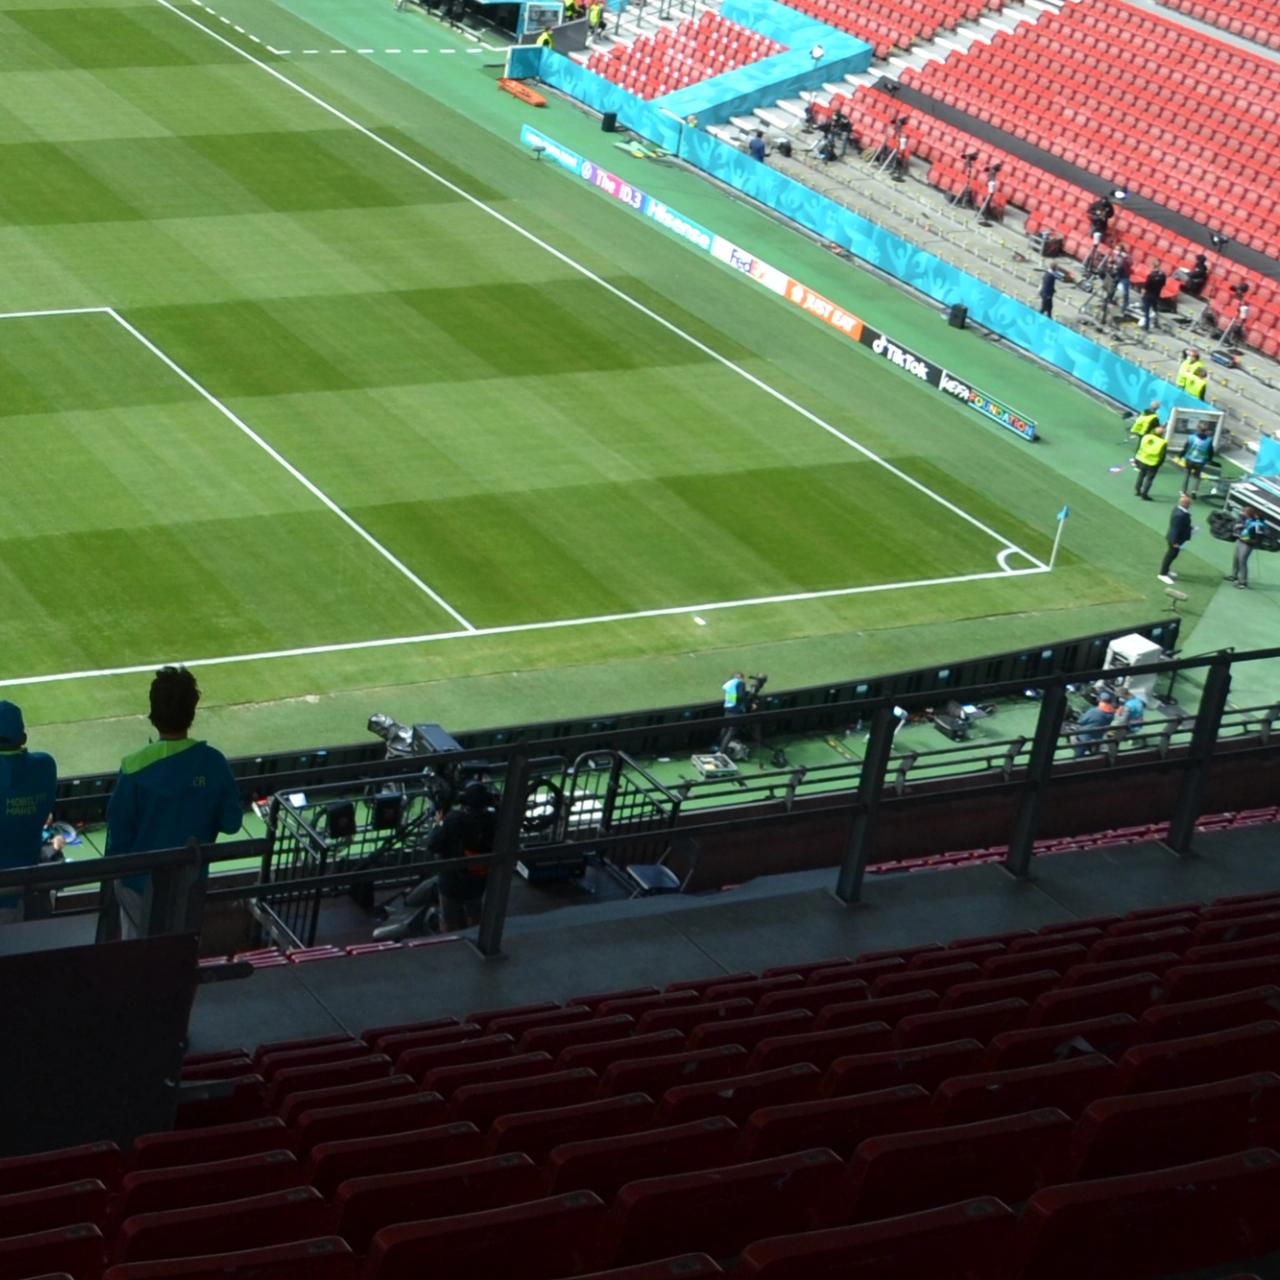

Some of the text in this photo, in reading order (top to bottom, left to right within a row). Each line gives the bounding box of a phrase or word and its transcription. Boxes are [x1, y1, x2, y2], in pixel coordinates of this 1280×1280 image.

[595, 169, 642, 209] The ID.3
[942, 375, 970, 401] UEFA
